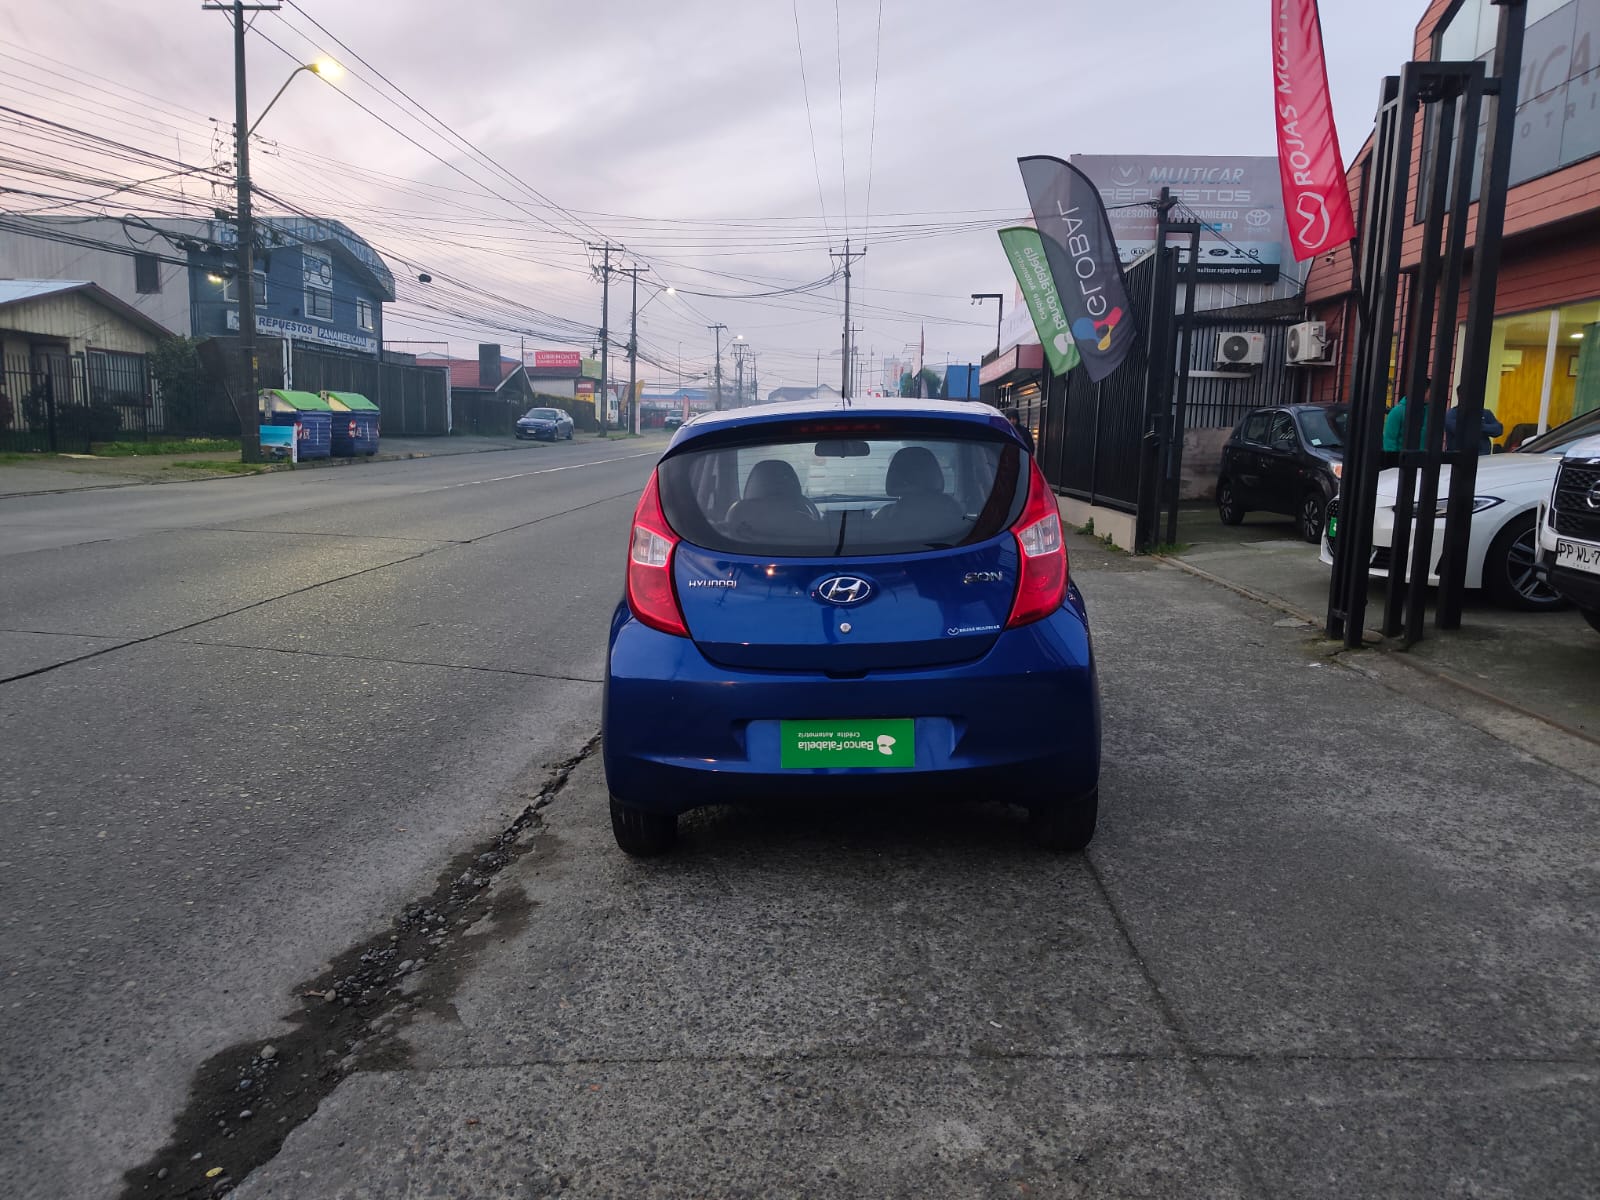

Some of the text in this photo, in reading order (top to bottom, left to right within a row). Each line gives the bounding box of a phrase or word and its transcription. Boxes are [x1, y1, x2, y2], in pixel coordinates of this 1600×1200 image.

[1279, 104, 1314, 186] ROJAS
[1147, 167, 1245, 185] MULTICAR
[1109, 209, 1158, 220] ACCESORIO
[258, 316, 313, 335] REPUESTOS
[689, 579, 737, 588] HYUNDAI
[798, 740, 874, 751] Banco Falabella
